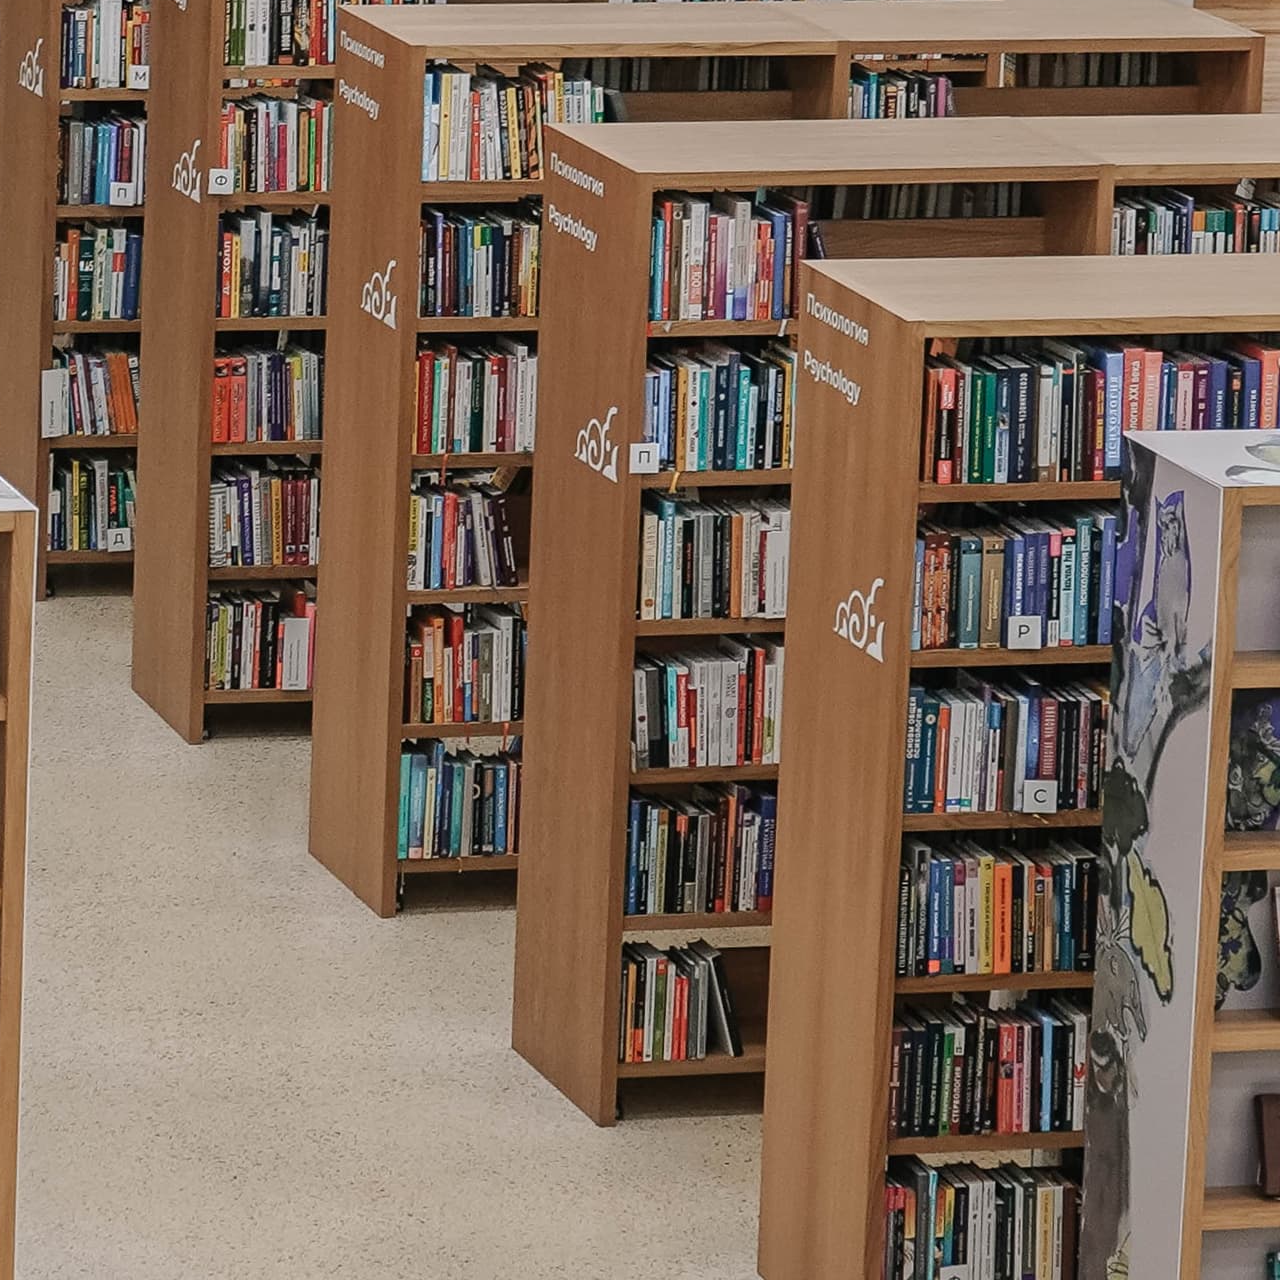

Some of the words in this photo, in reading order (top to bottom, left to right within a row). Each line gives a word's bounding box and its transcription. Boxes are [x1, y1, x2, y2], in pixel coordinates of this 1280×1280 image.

[340, 30, 385, 69] Психология
[134, 71, 146, 82] М
[339, 79, 380, 121] Psychology
[550, 152, 604, 197] Психология
[117, 187, 127, 198] П
[548, 204, 597, 252] Psychology
[806, 292, 869, 346] Психология
[804, 350, 861, 406] Psychology
[639, 451, 650, 464] П
[113, 533, 125, 547] Д
[1018, 625, 1030, 638] Р
[1033, 788, 1047, 803] С
